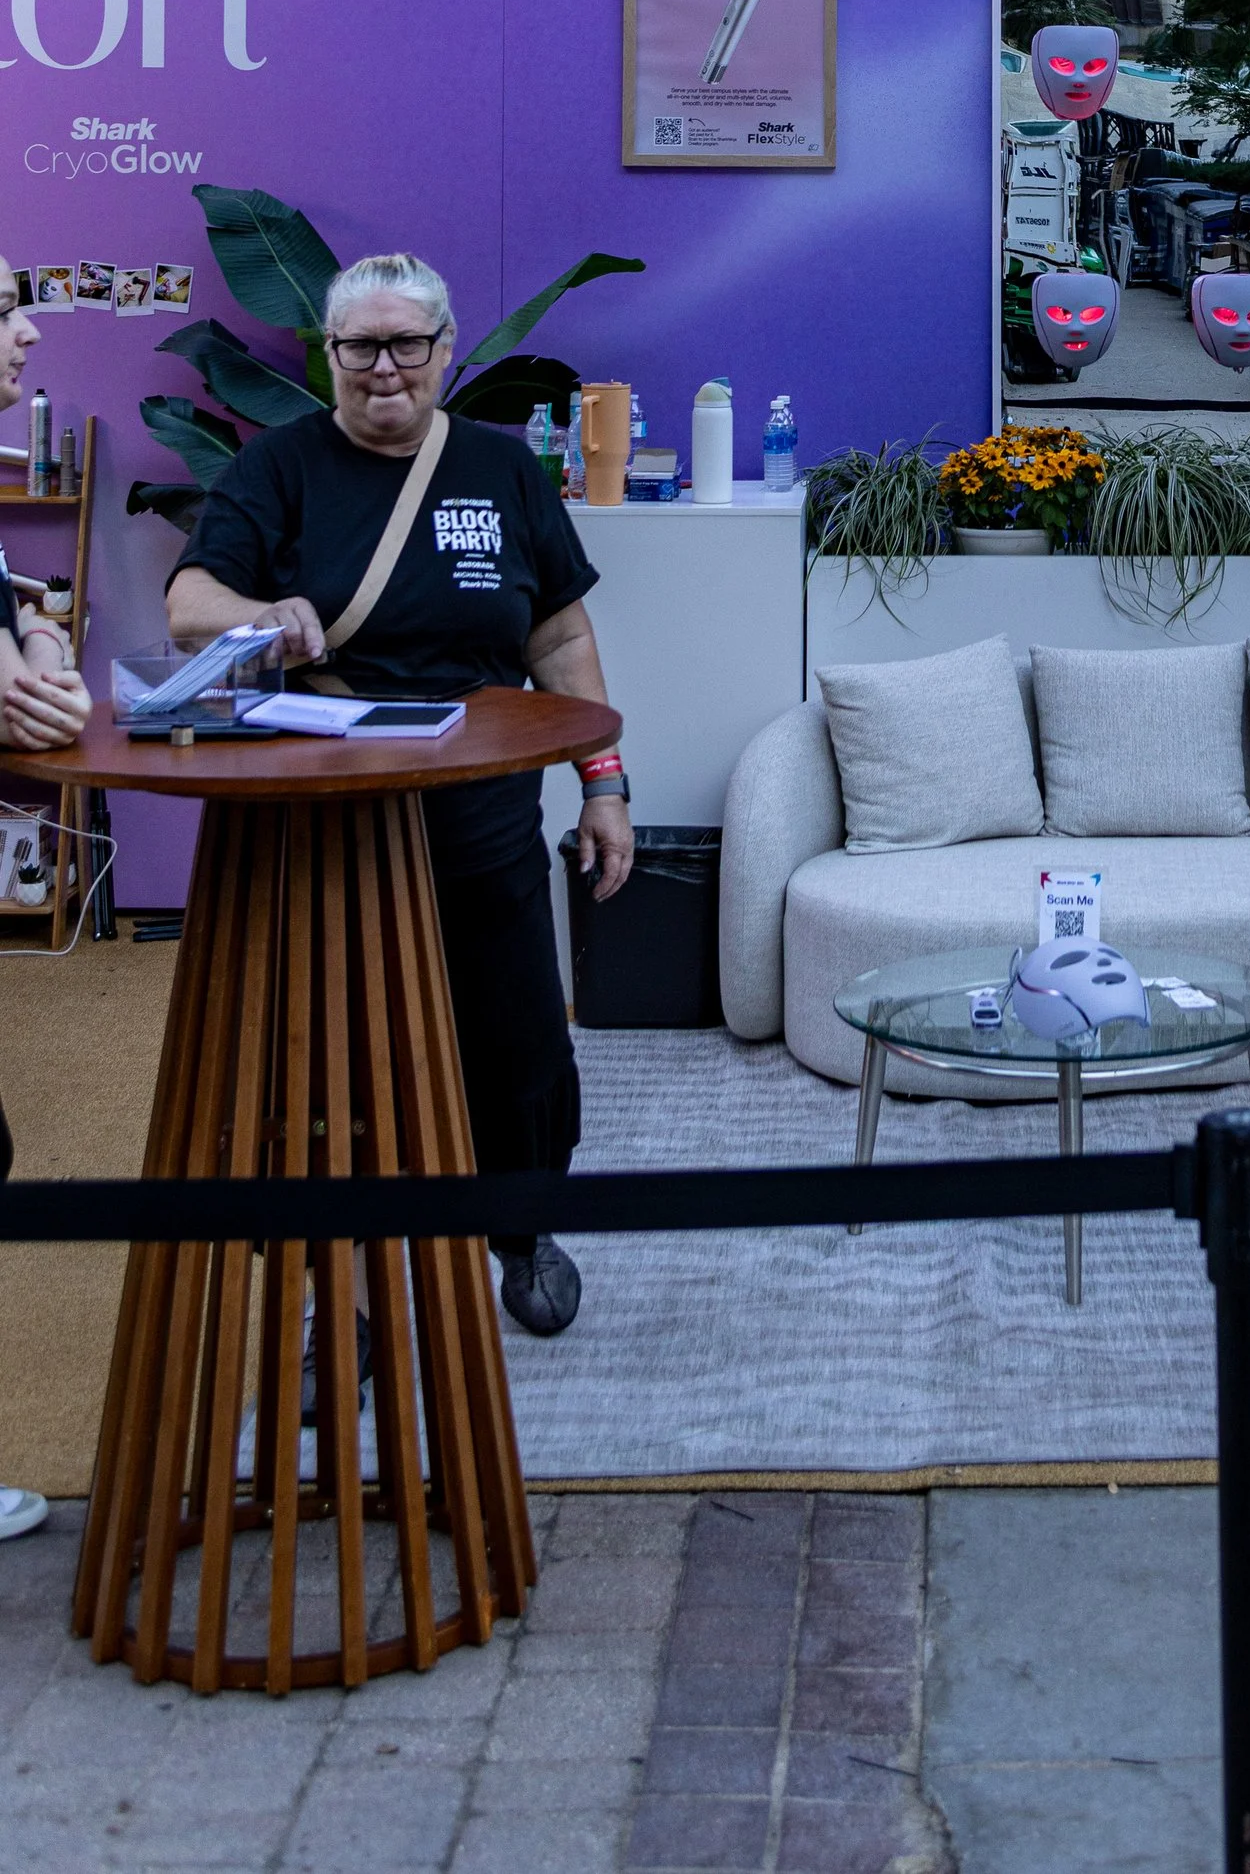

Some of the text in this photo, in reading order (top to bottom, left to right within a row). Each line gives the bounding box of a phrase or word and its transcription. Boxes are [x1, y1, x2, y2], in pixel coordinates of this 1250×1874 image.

[70, 117, 158, 141] Shark
[748, 133, 805, 146] FlexStyle
[758, 122, 795, 133] Shark
[24, 144, 203, 179] CryoGlow
[433, 509, 501, 535] BLOCK
[436, 530, 502, 555] PARTY
[1047, 894, 1094, 905] Scan Me
